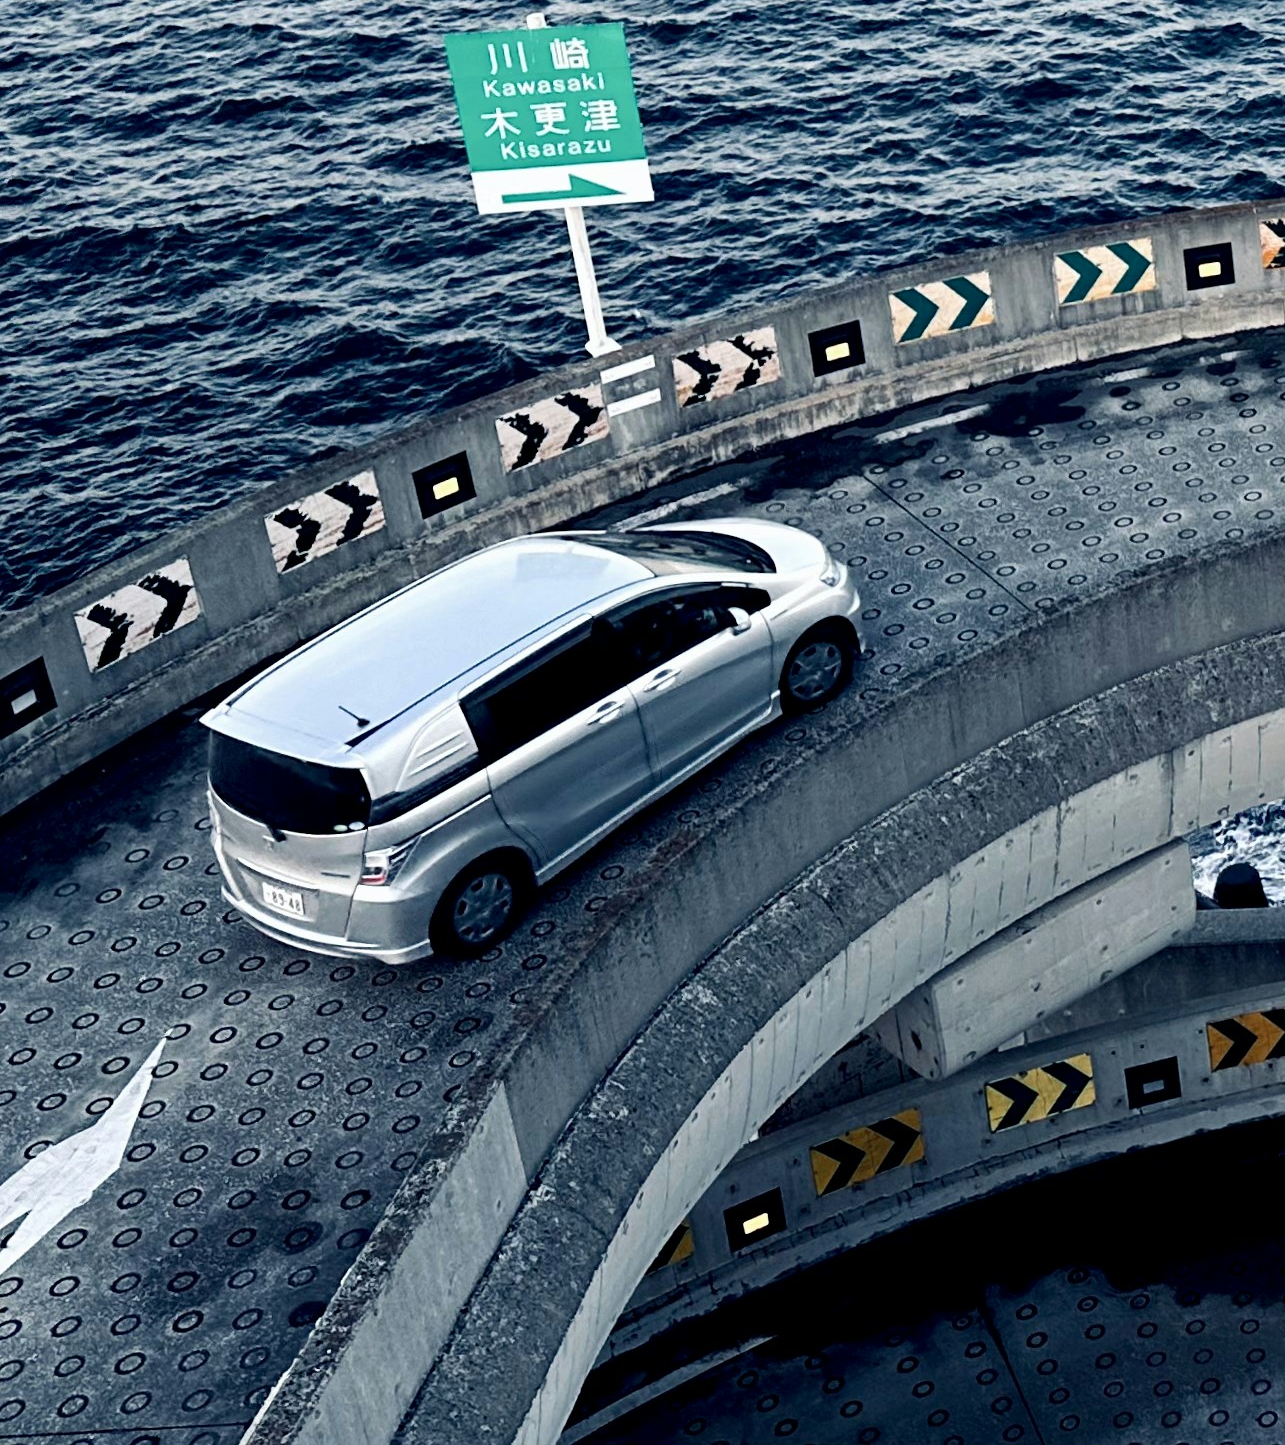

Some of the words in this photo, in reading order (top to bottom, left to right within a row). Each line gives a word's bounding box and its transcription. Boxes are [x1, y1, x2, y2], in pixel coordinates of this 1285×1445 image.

[488, 37, 591, 75] 川崎
[482, 72, 605, 98] Kawasaki
[481, 99, 621, 139] 木更津
[502, 139, 612, 160] Kisarazu
